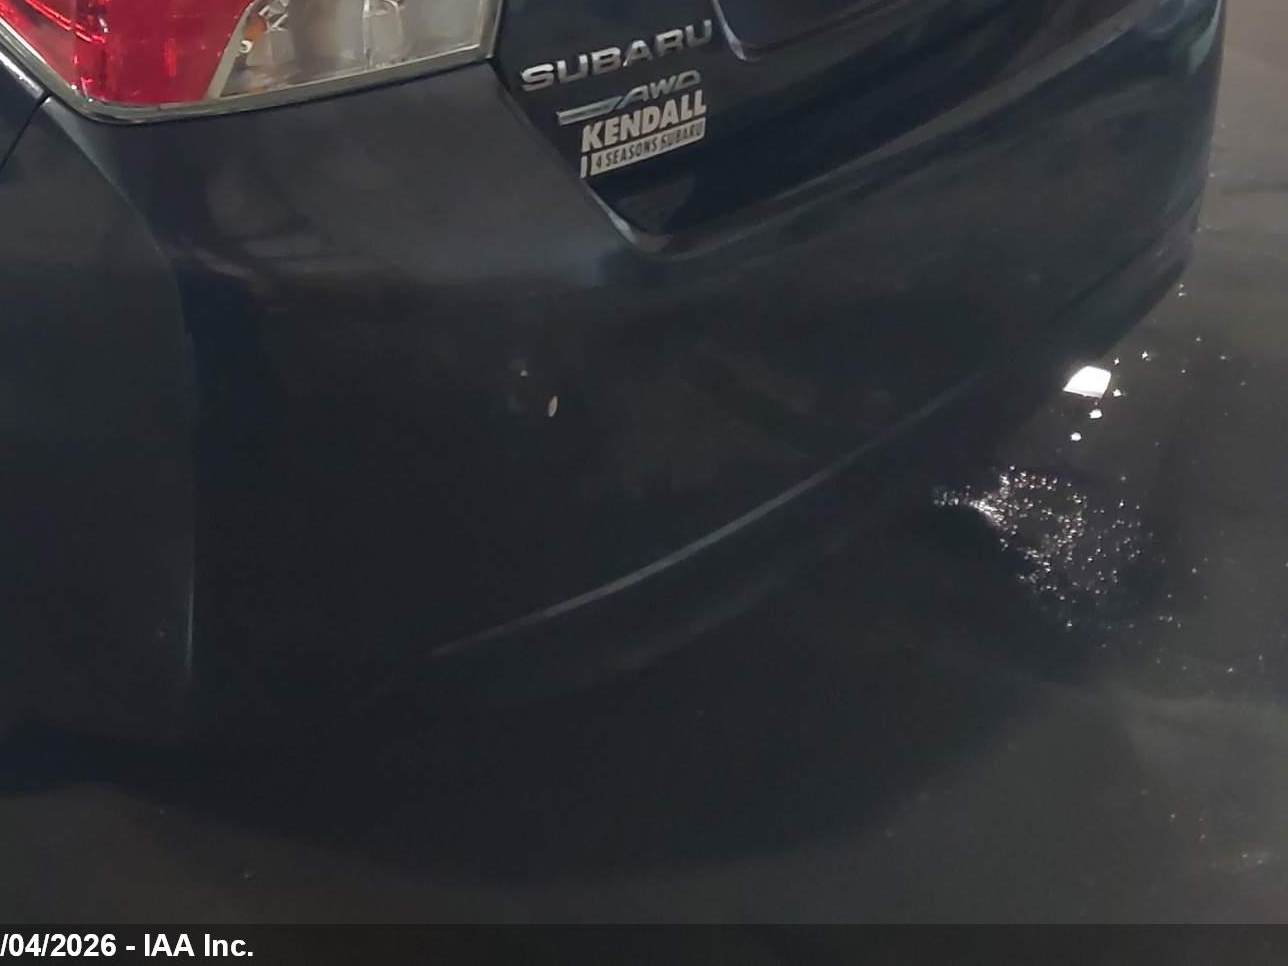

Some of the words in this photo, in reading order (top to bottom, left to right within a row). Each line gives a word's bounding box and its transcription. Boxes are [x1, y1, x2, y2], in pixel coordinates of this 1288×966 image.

[520, 18, 712, 92] SUBARU
[615, 69, 702, 110] AWD
[580, 89, 707, 152] KENDALL
[595, 154, 603, 169] 4
[605, 137, 658, 168] SEASONS
